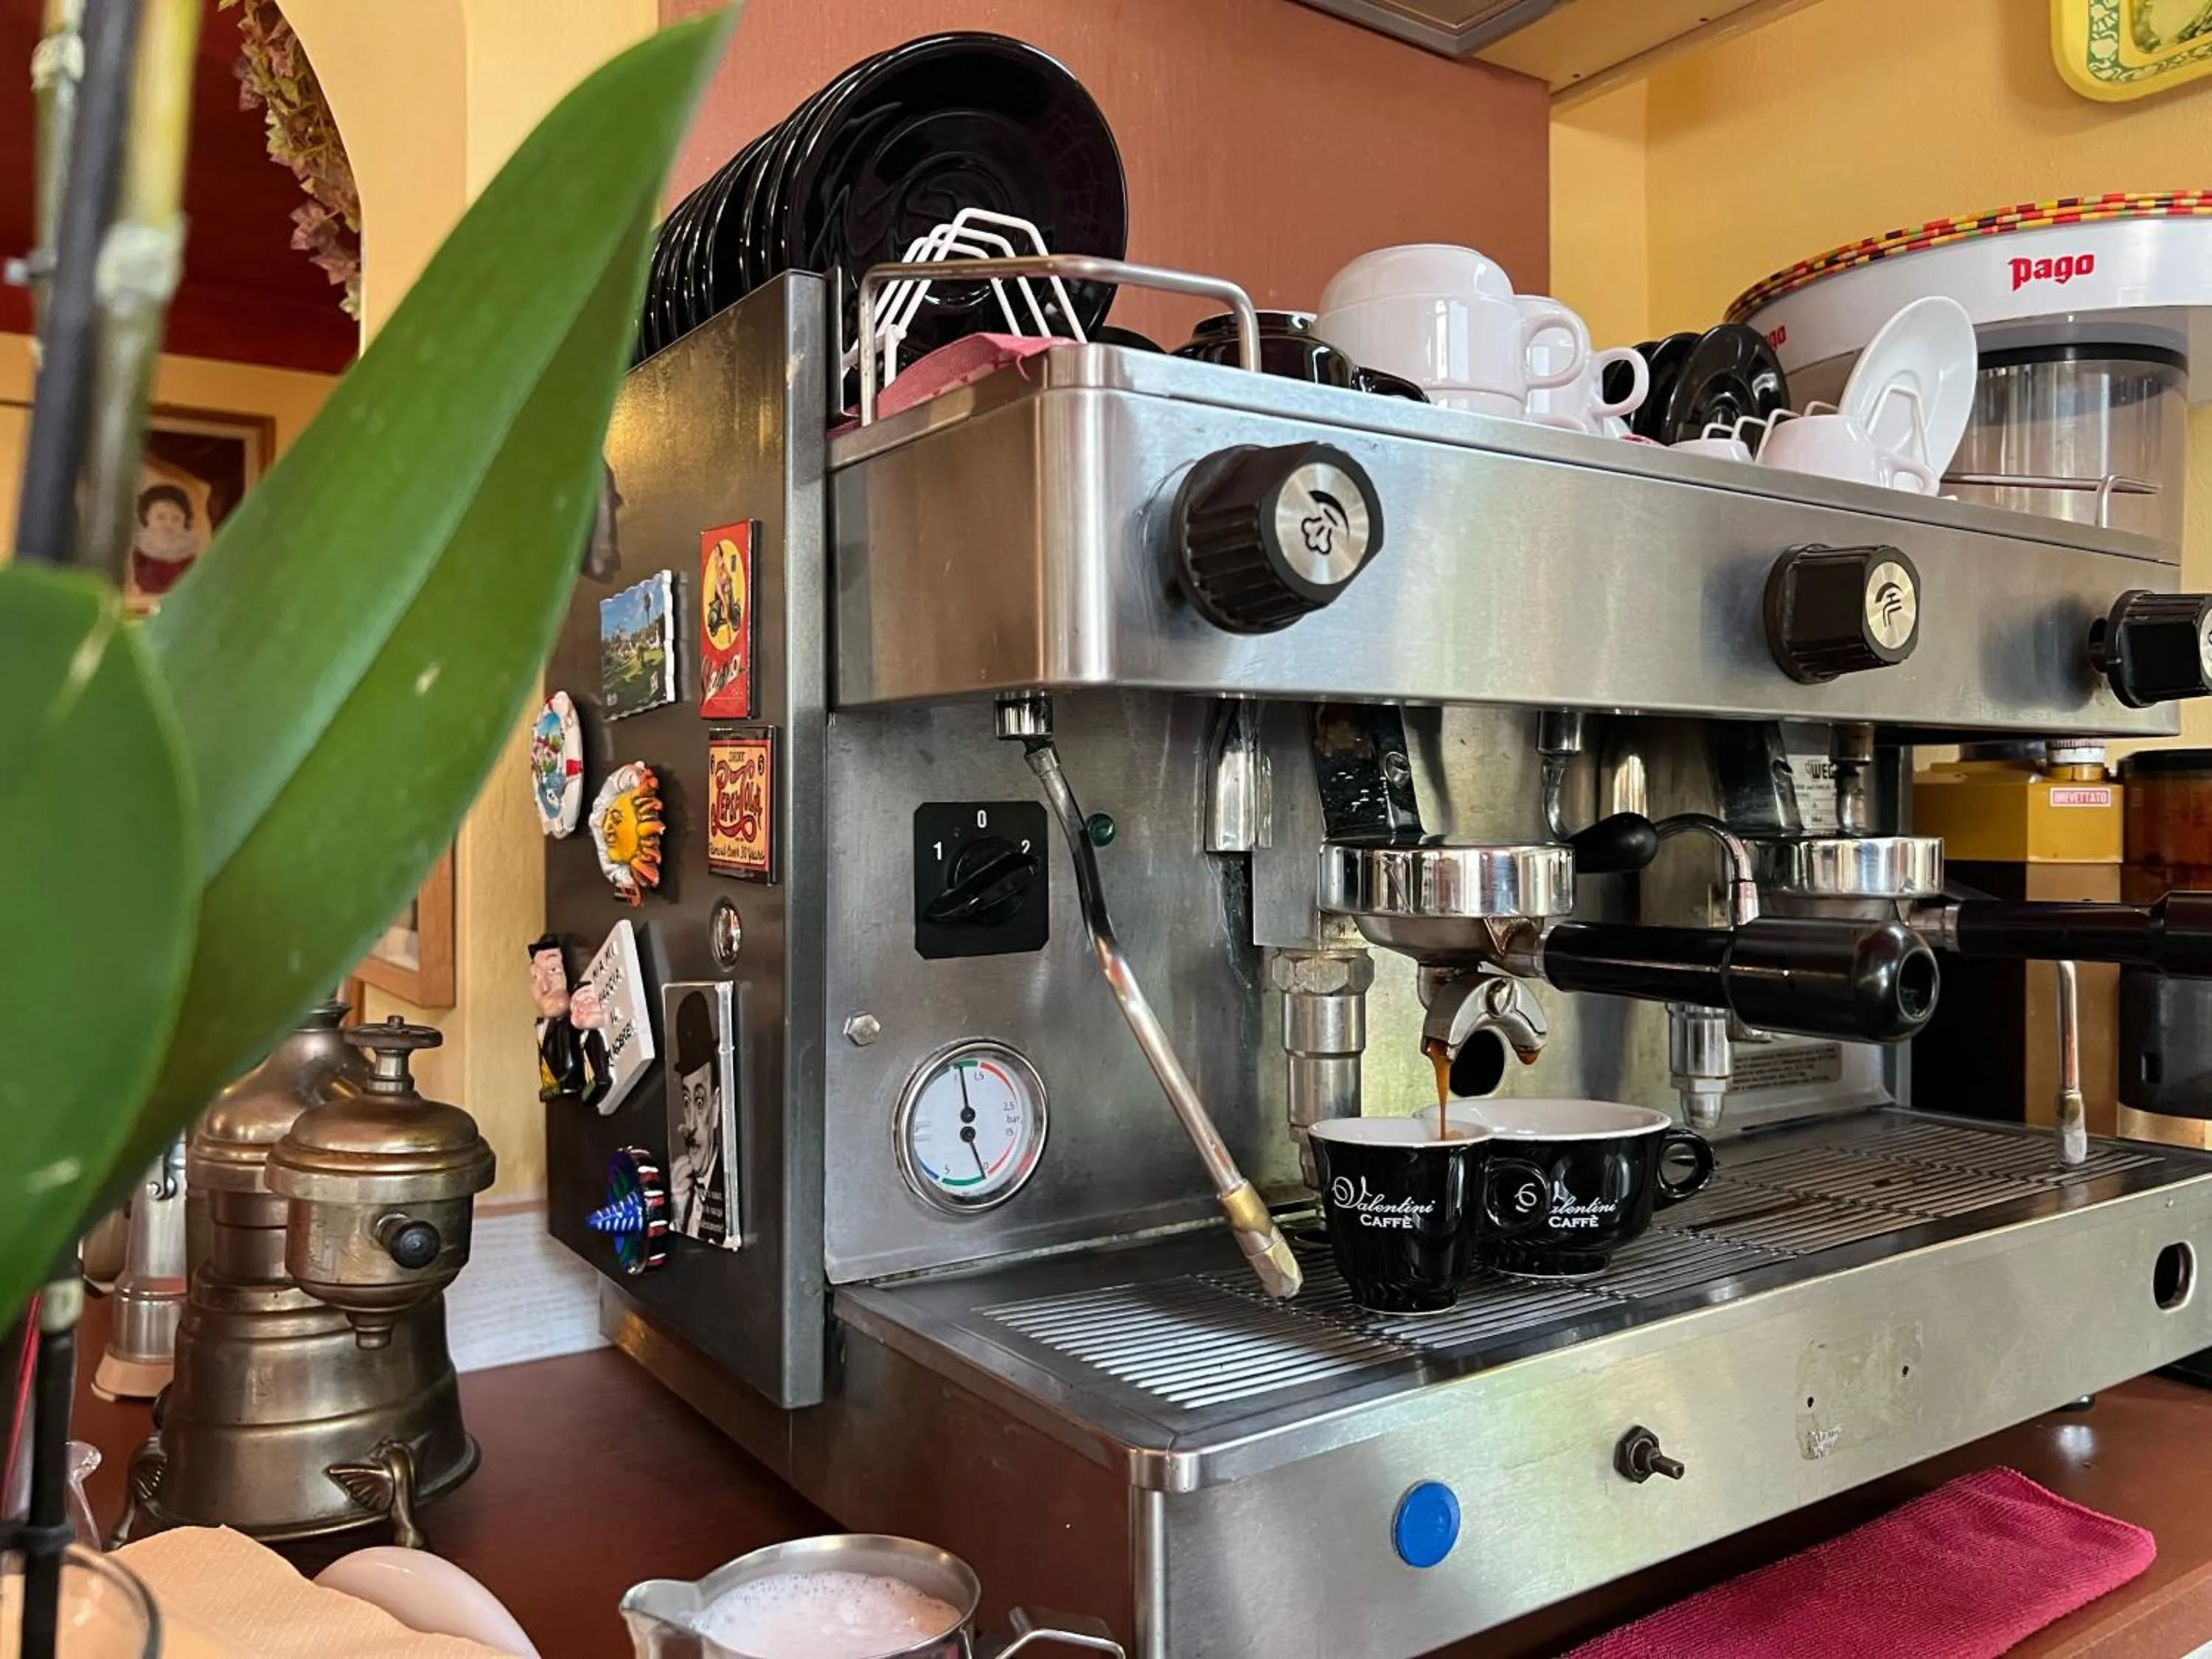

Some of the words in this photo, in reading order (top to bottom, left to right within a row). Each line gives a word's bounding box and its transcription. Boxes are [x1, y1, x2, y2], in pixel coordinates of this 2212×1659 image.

[1764, 325, 1787, 350] go
[1811, 762, 1835, 779] WEG
[977, 810, 987, 828] 0
[933, 842, 942, 860] 1
[1021, 840, 1031, 854] 2
[1332, 1175, 1436, 1214] Valentini
[1360, 1214, 1413, 1228] CAFFÈ
[1548, 1214, 1599, 1228] CAFFÈ
